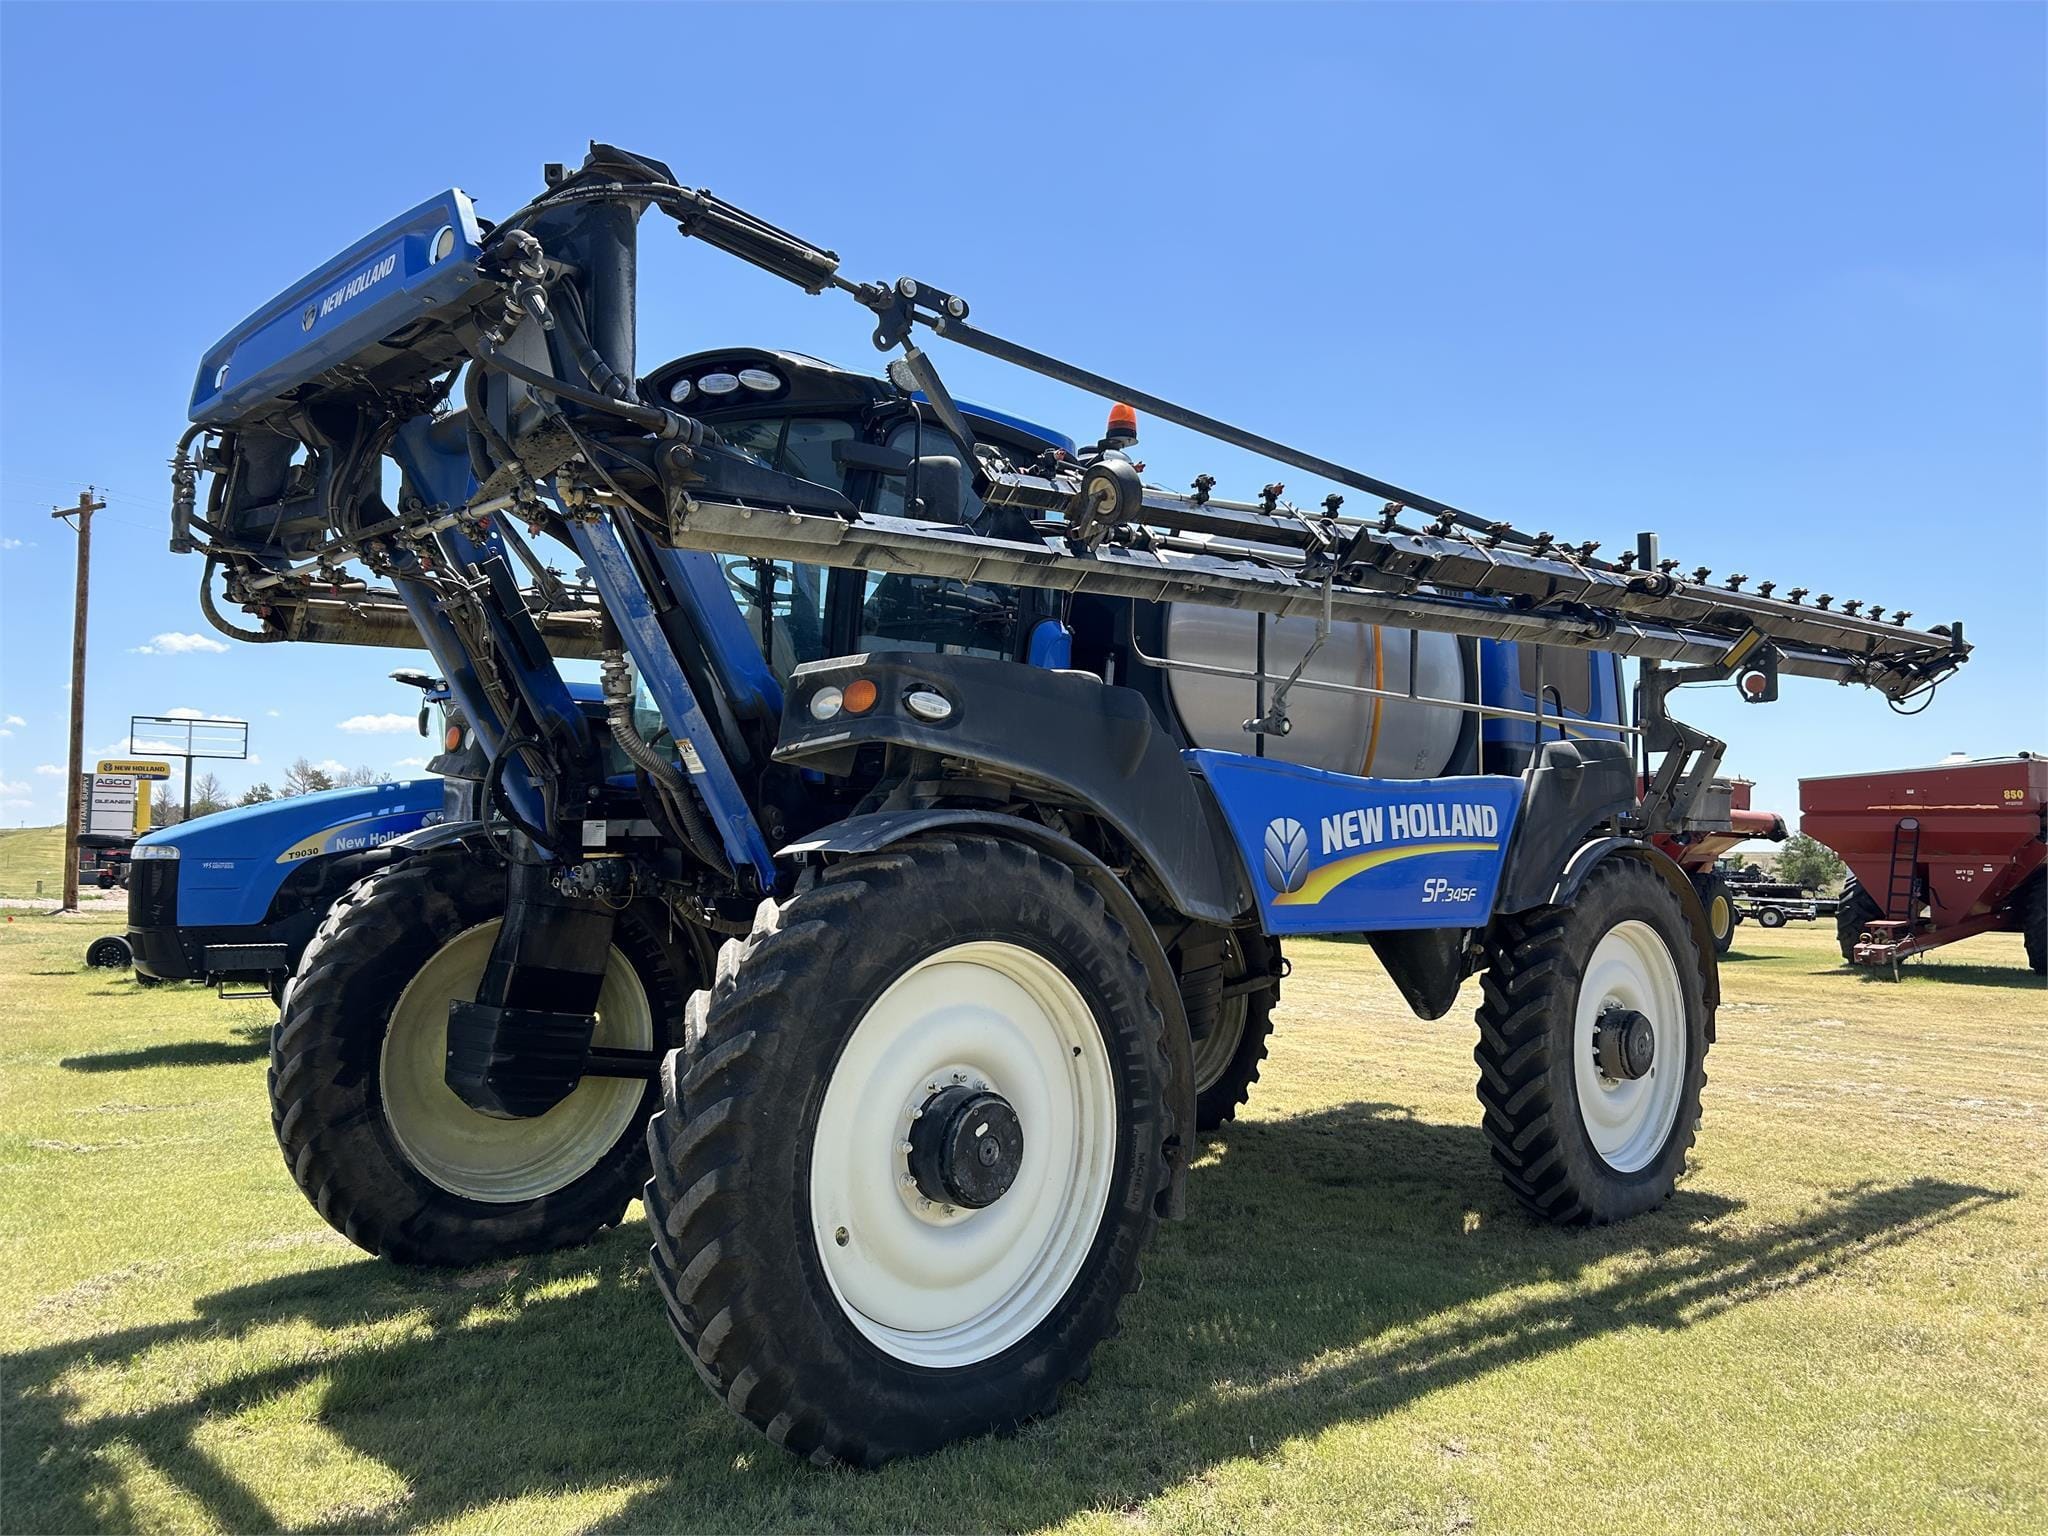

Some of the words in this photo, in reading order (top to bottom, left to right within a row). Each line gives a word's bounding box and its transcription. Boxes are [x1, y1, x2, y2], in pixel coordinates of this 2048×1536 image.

[320, 286, 347, 318] NEW
[344, 253, 397, 303] HOLLAND
[96, 778, 132, 786] AGCO
[2003, 789, 2025, 800] 850
[336, 837, 366, 851] New
[1321, 806, 1384, 855] NEW
[1389, 803, 1498, 840] HOLLAND
[288, 847, 319, 860] T9030
[1054, 913, 1149, 1103] MICHELIN
[1131, 1152, 1145, 1205] MICHELIN
